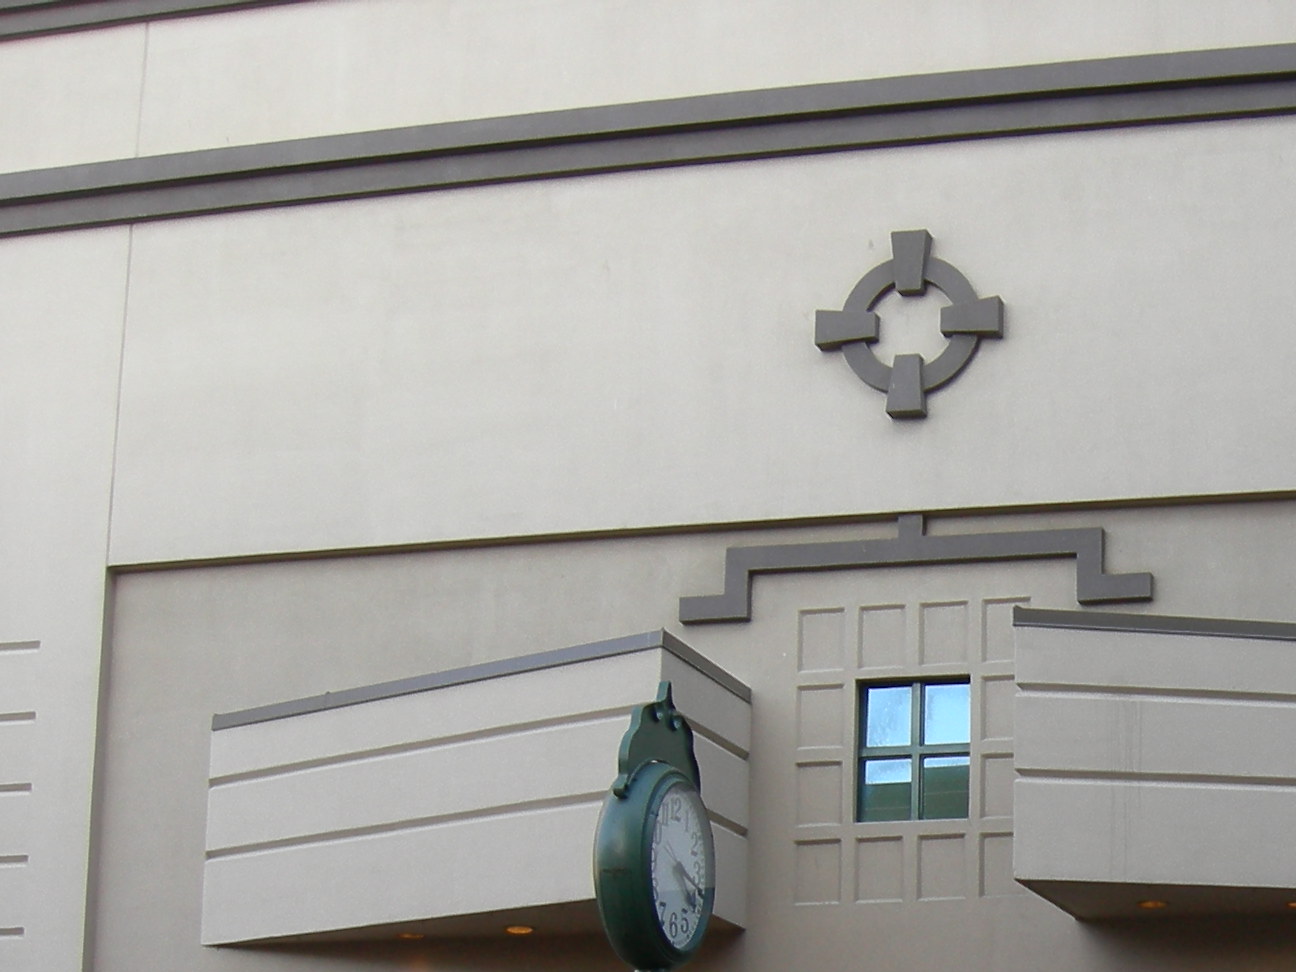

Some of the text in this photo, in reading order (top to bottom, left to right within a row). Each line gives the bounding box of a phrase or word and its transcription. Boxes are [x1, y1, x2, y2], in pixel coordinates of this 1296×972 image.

[670, 797, 682, 822] 12
[691, 832, 698, 857] 2
[659, 901, 667, 923] 7
[681, 908, 689, 934] 5
[669, 912, 678, 939] 6
